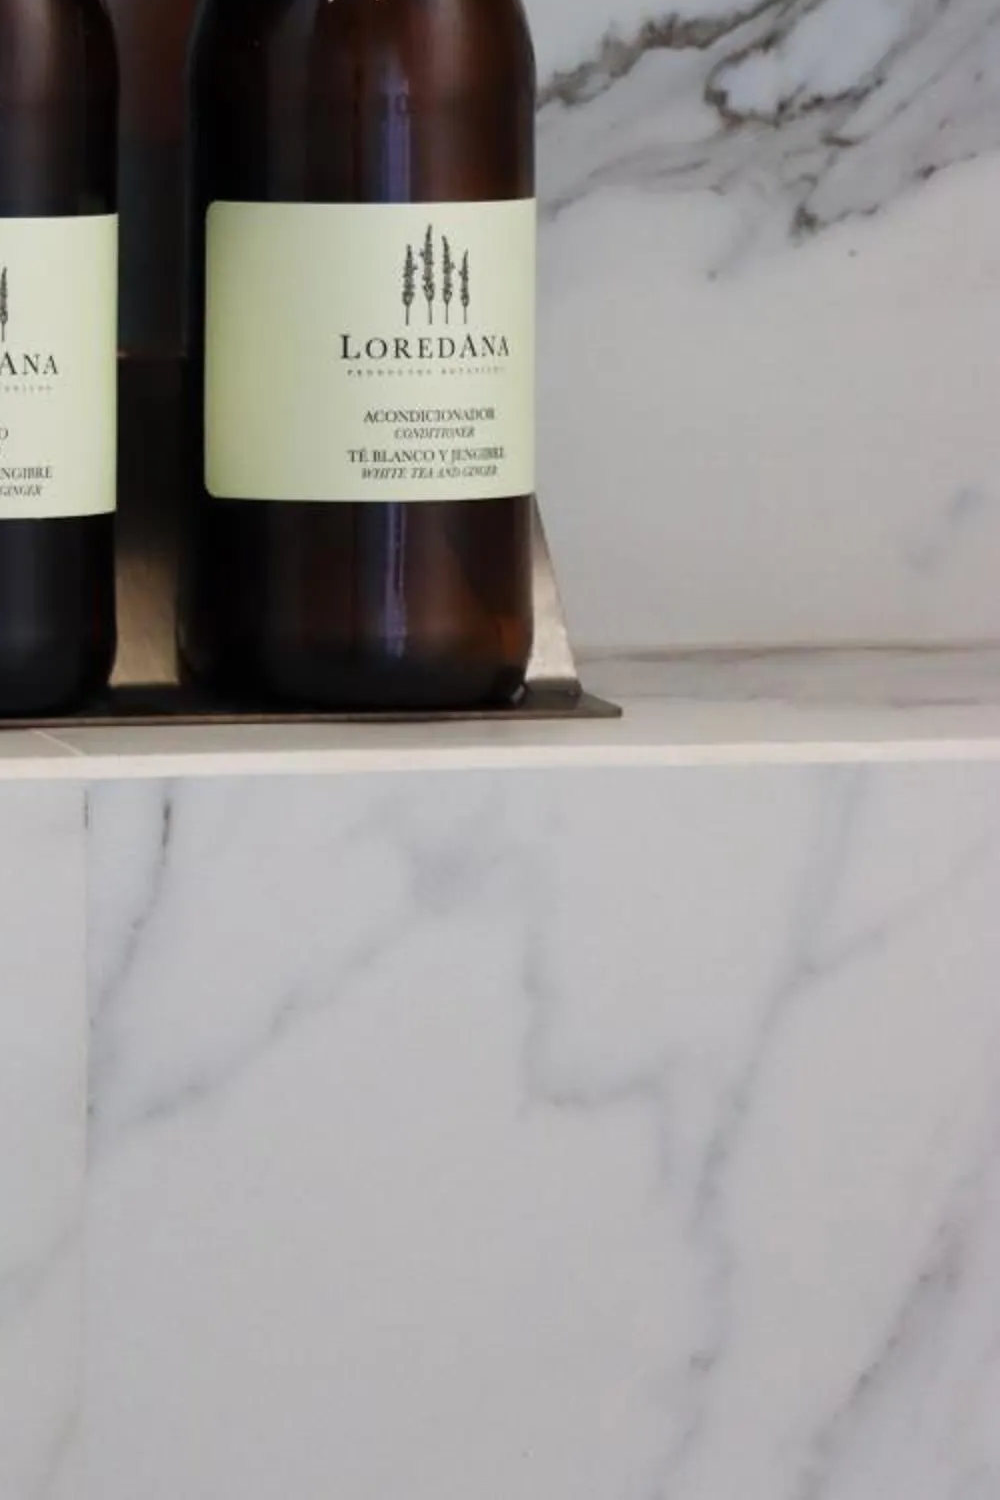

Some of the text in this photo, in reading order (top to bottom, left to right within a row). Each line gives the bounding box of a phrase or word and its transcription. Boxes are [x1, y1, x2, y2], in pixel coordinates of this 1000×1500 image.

[340, 333, 510, 360] LOREDANA
[363, 407, 495, 423] ACONDICIONADOR
[373, 449, 435, 463] BLANCO
[438, 449, 449, 462] Y
